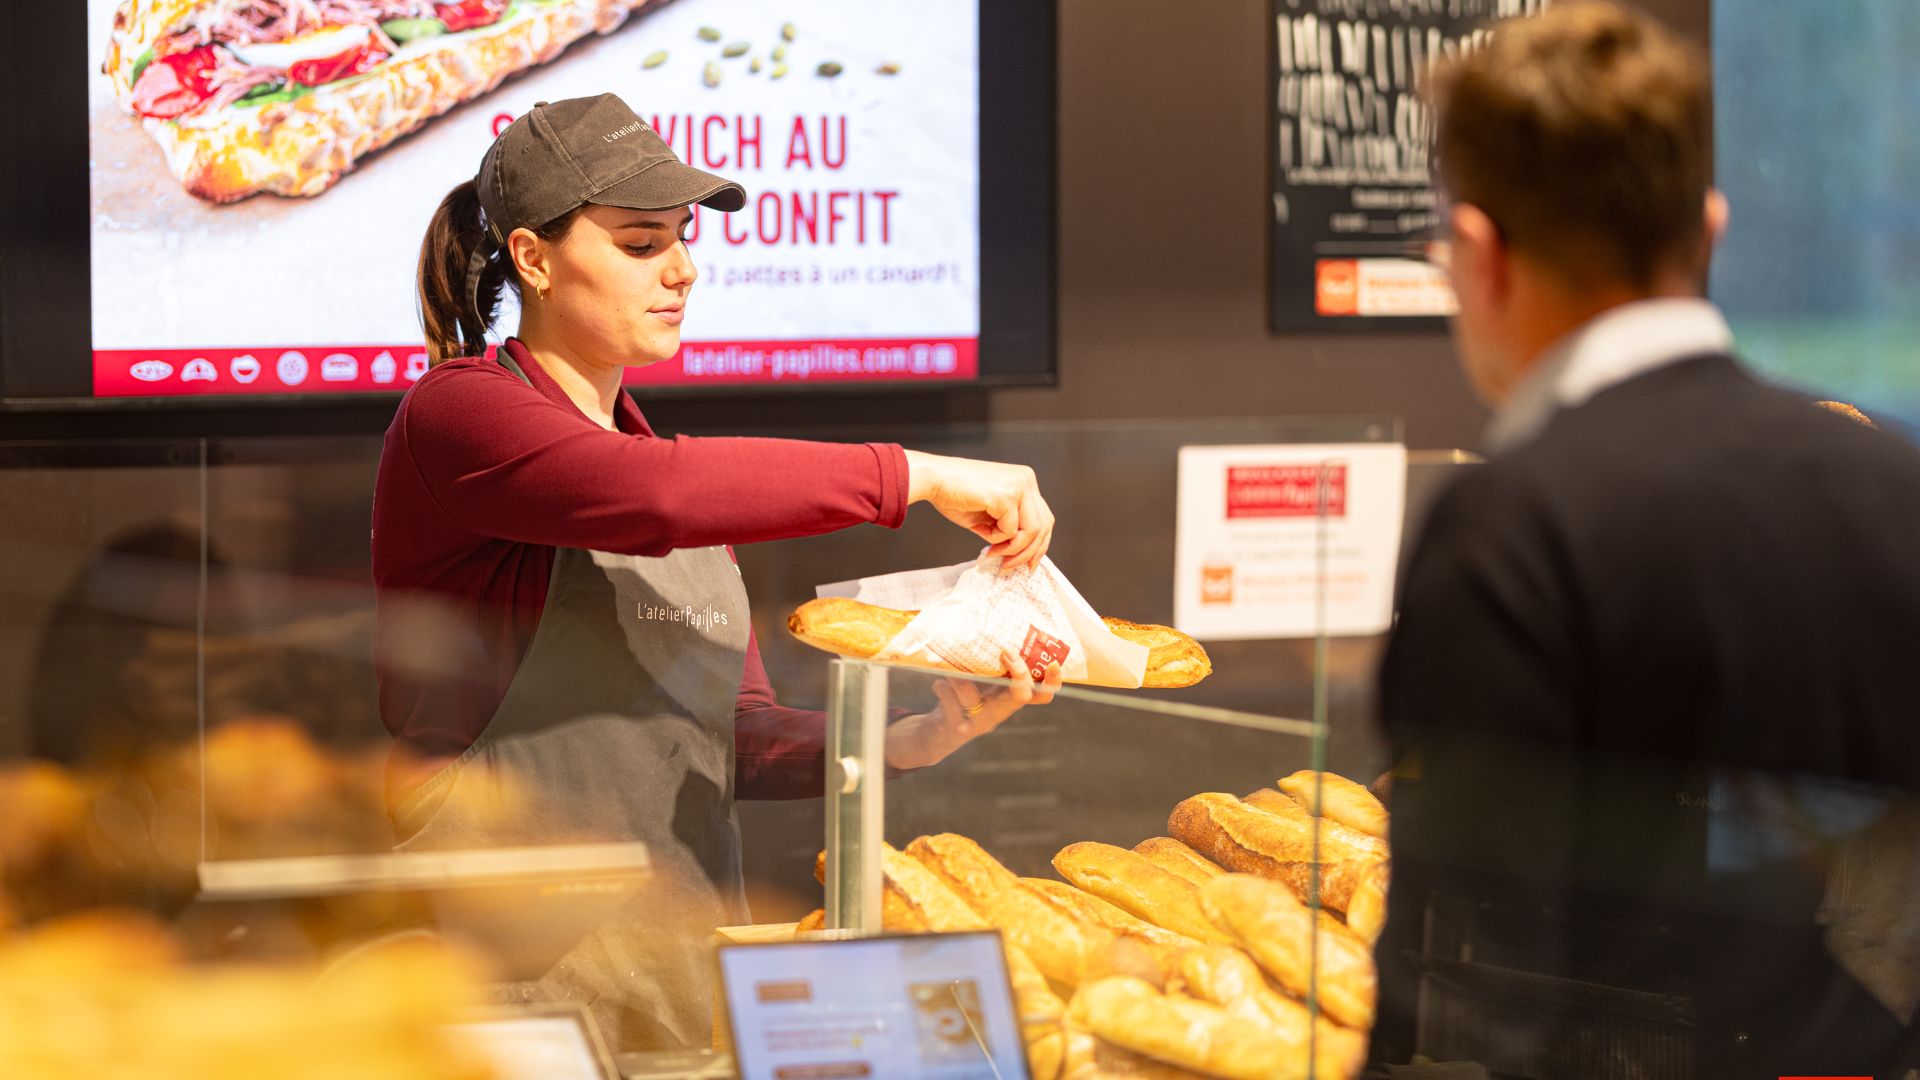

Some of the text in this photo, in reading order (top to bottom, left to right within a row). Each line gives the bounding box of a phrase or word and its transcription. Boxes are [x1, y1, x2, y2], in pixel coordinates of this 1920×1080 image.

[785, 114, 847, 169] AU
[722, 190, 899, 245] CONFIT
[724, 264, 802, 288] pattes
[809, 261, 823, 286] à
[829, 265, 860, 286] un
[1031, 639, 1062, 678] L'ate
